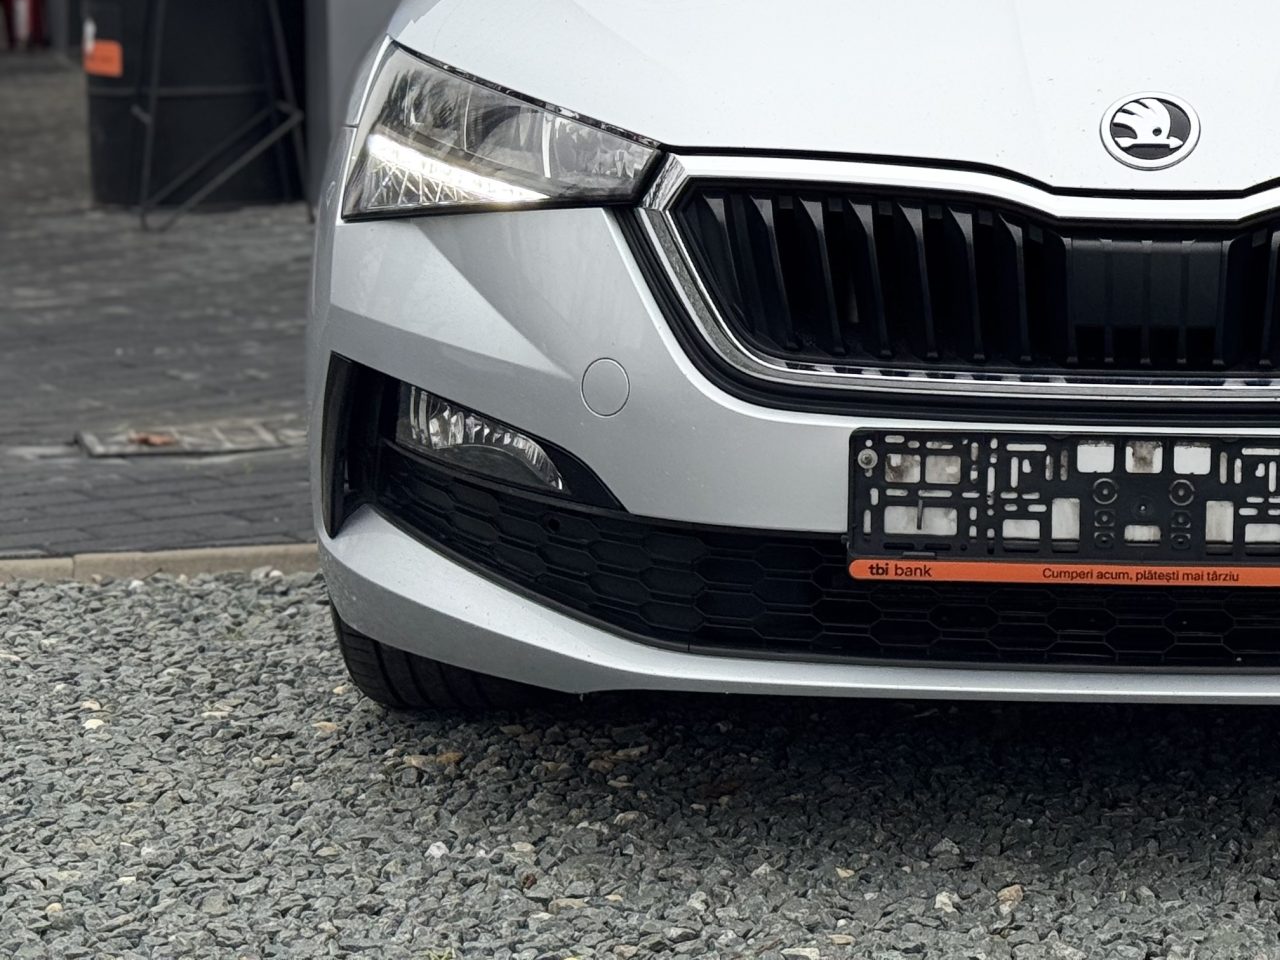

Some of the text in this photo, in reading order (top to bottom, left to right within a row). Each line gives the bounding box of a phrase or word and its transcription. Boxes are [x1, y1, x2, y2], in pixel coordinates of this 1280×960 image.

[868, 563, 932, 577] tbi bank
[1042, 567, 1093, 581] Cumperi
[1096, 569, 1133, 581] acum,
[1182, 571, 1204, 582] mai
